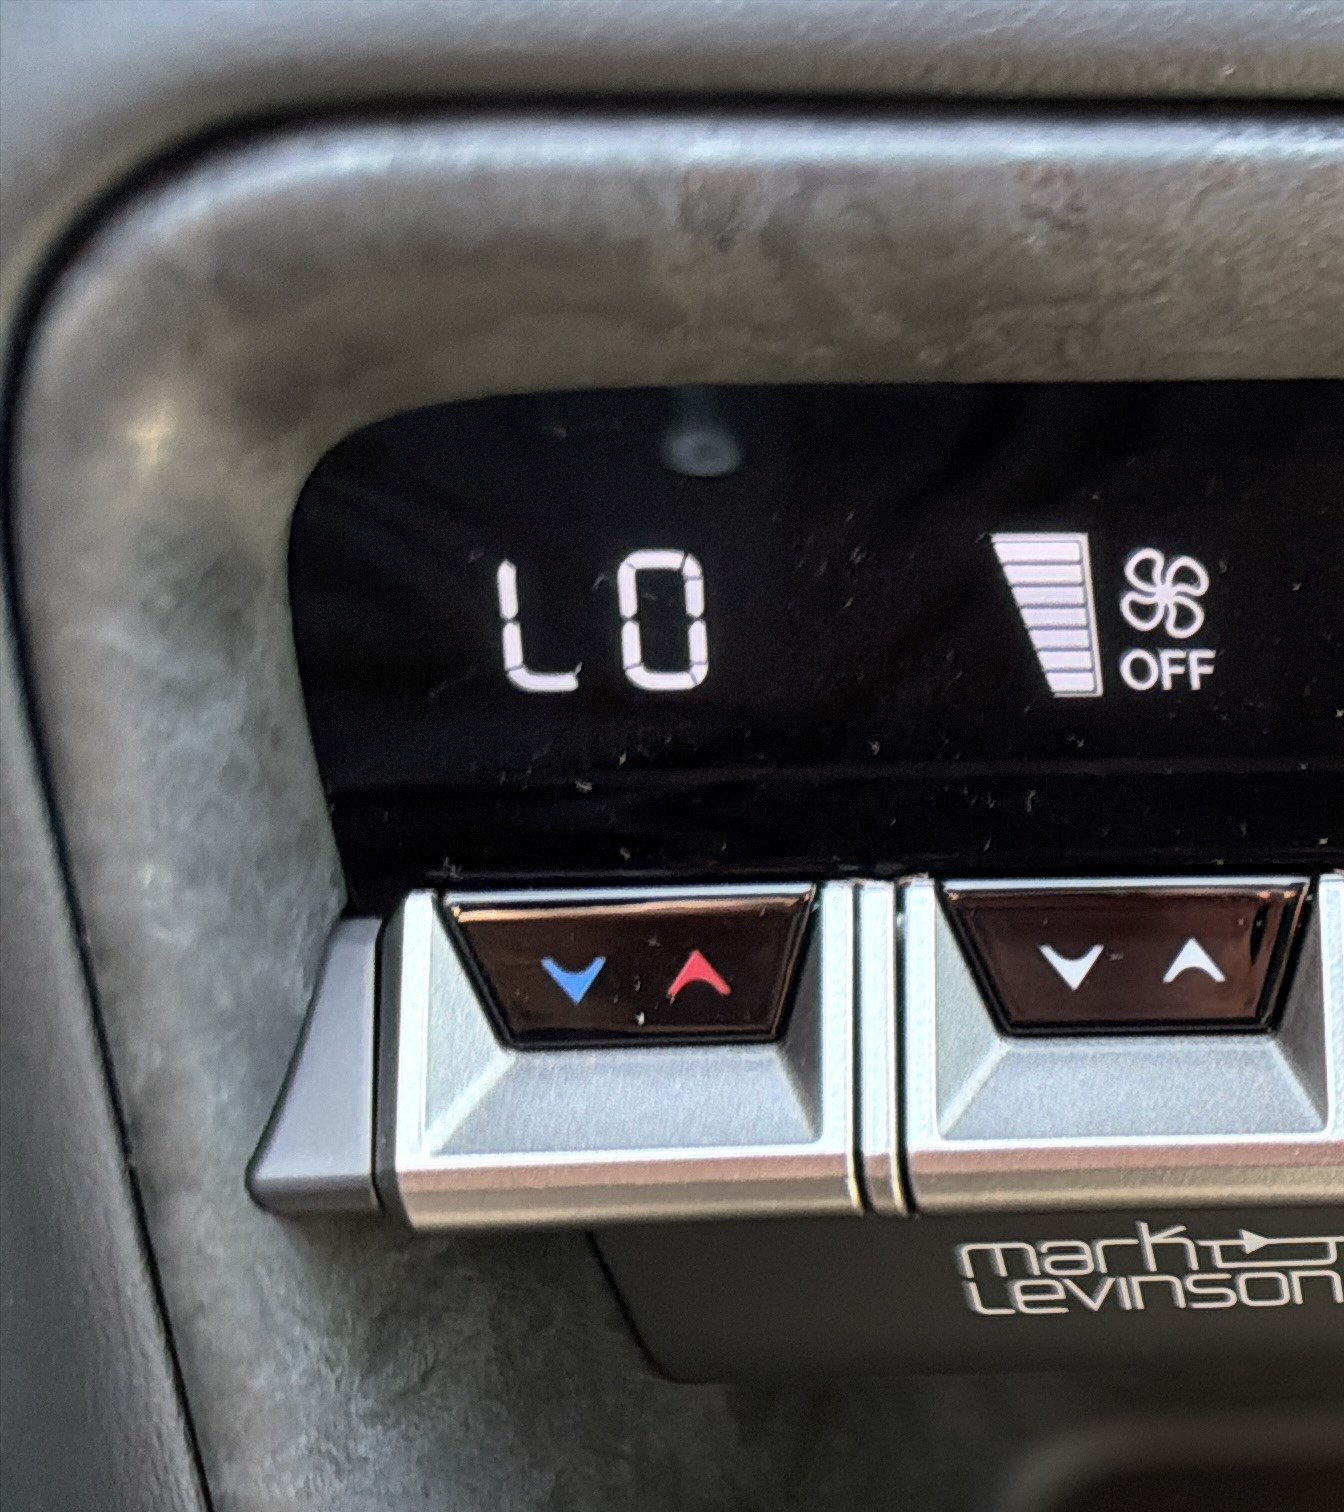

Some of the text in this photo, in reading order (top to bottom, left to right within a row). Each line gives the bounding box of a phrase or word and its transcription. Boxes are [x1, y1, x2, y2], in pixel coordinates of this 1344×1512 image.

[496, 549, 710, 693] LO
[1118, 647, 1217, 692] OFF
[958, 1221, 1201, 1278] mark
